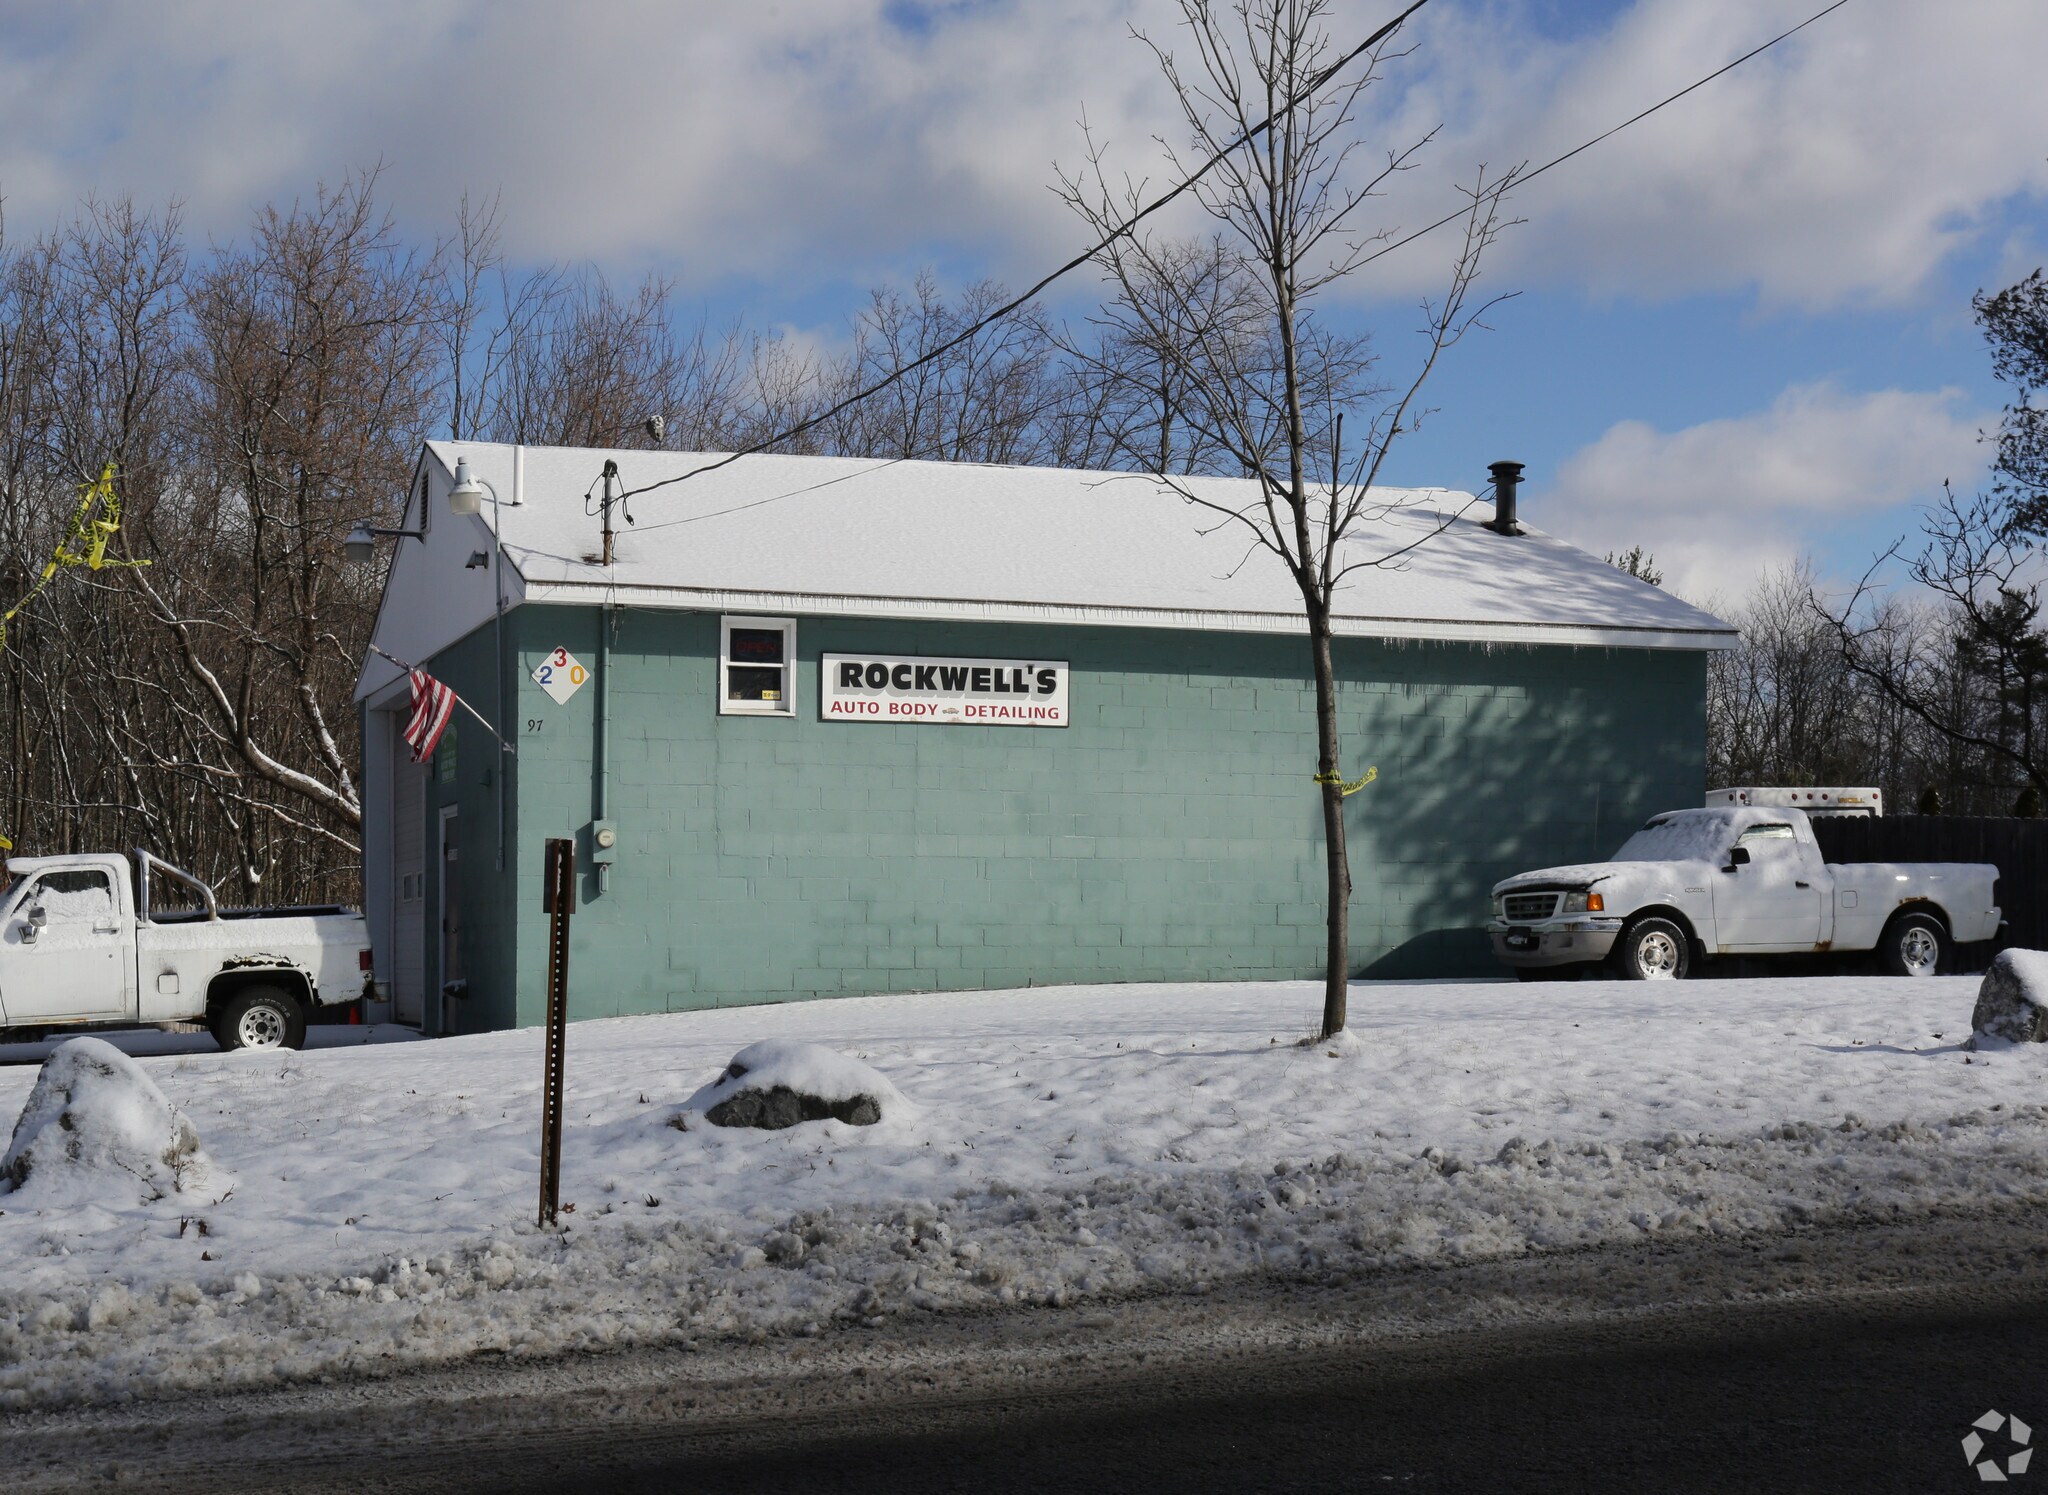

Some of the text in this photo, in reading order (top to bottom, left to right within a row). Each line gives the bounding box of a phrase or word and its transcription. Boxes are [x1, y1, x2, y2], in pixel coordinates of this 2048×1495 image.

[553, 648, 567, 667] 3
[539, 665, 553, 684] 2
[570, 665, 585, 684] 0
[839, 662, 1057, 695] ROCKWELL'S
[830, 701, 1059, 720] AUTO BODY DETAILING
[527, 719, 544, 732] 97
